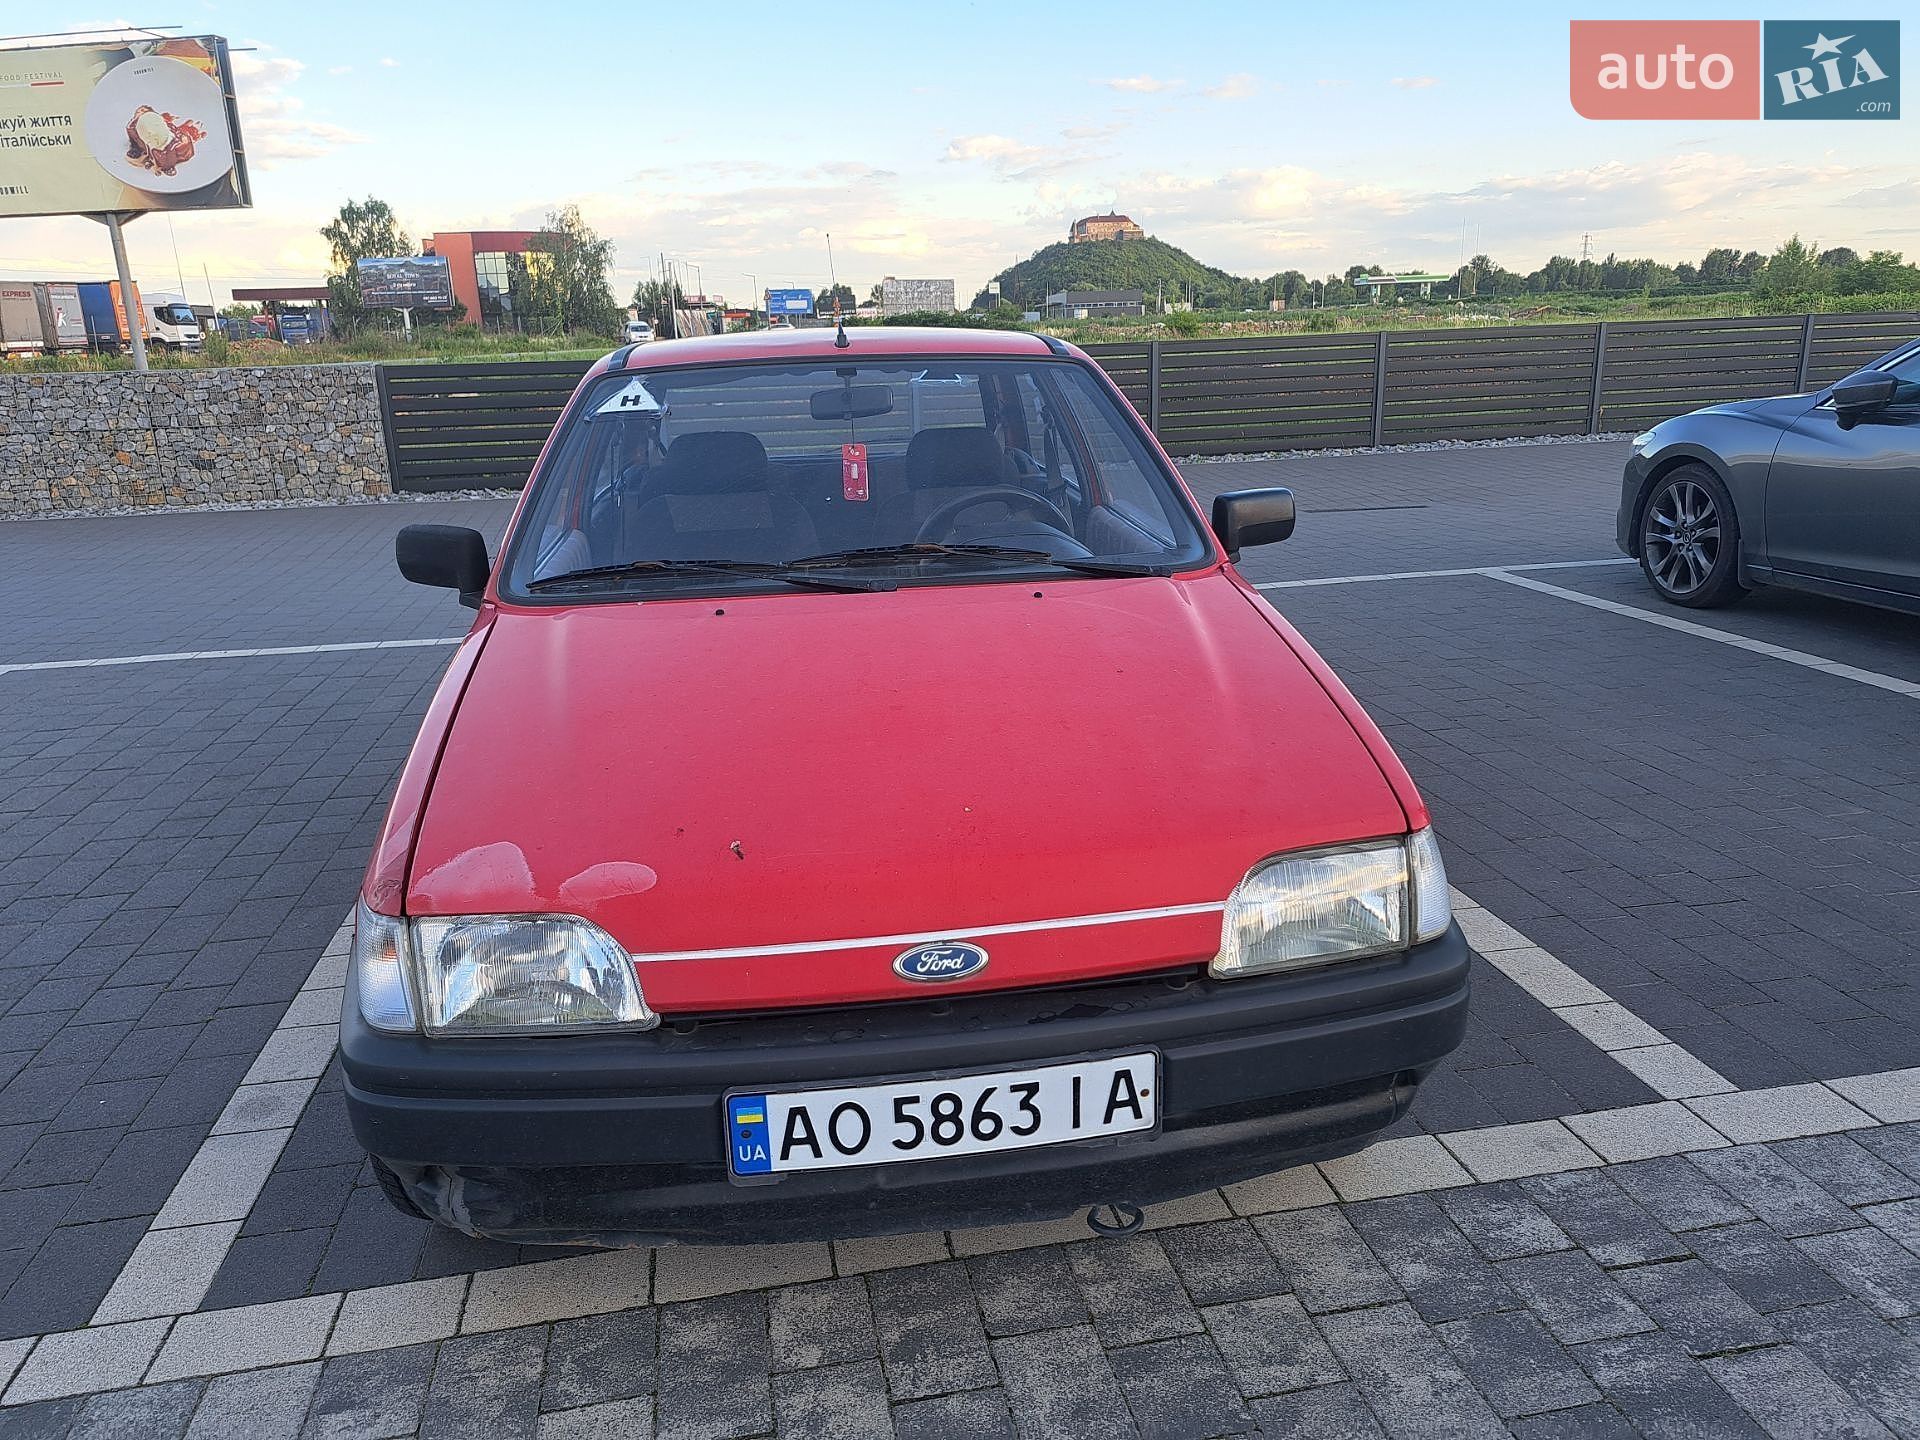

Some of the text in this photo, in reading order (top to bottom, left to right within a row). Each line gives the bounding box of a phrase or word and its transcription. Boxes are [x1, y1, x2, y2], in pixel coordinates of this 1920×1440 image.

[24, 71, 63, 80] FESTIVAL
[29, 115, 72, 128] життя
[916, 949, 965, 972] Ford
[779, 1069, 1143, 1161] AO 5863 IA
[738, 1144, 767, 1162] UA
